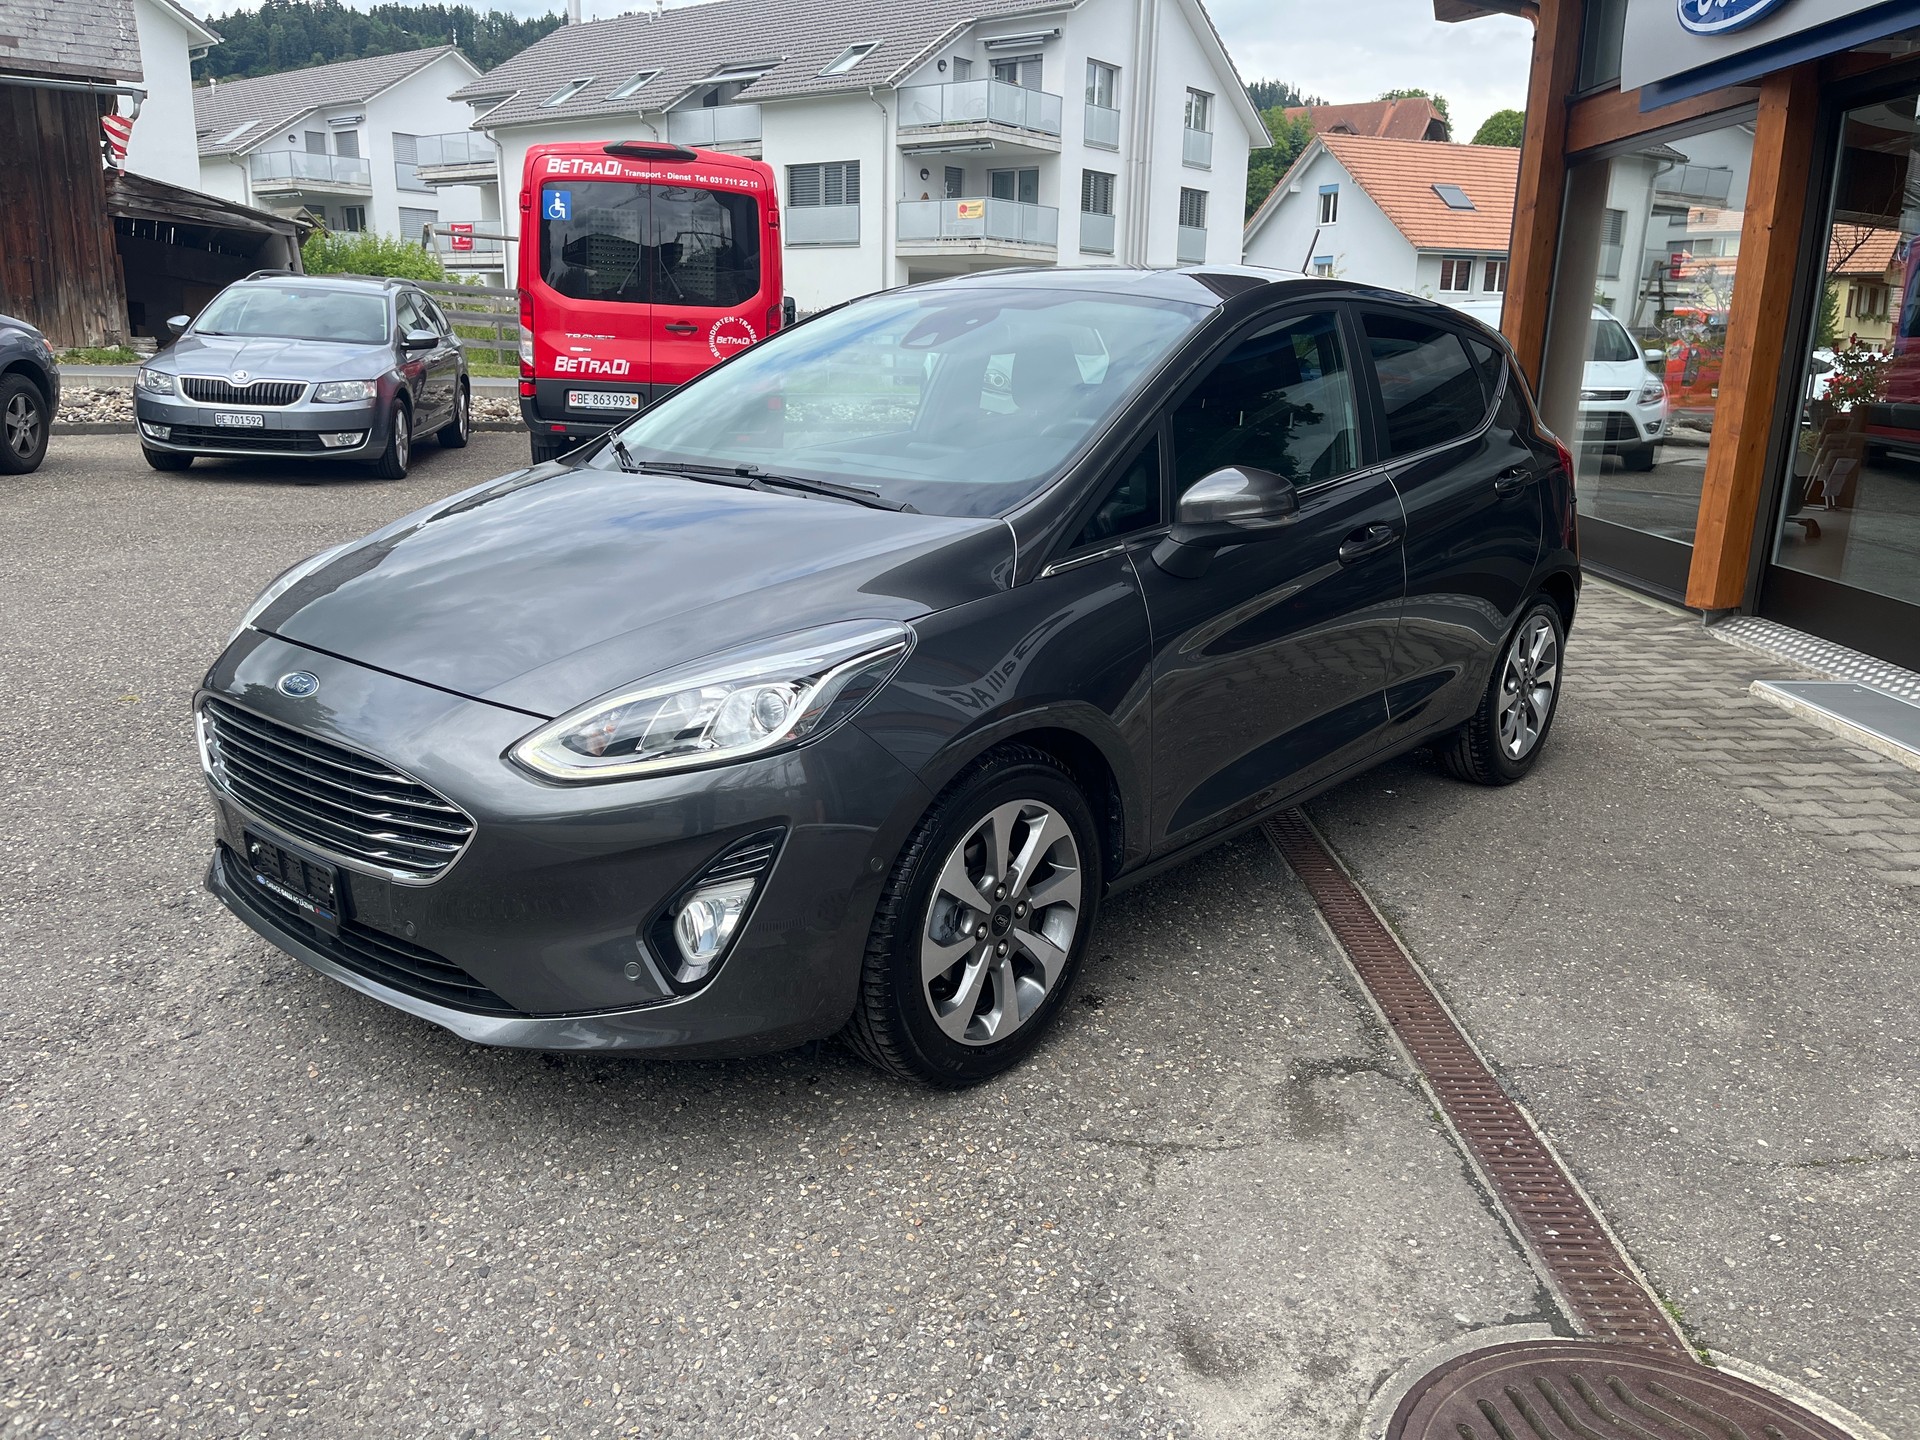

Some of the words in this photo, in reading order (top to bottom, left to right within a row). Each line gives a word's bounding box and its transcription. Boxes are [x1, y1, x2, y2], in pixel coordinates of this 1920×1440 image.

[623, 169, 661, 179] Transport
[667, 172, 692, 181] Dienst
[694, 174, 708, 183] Tel.
[709, 176, 723, 184] 031
[724, 178, 738, 186] 711
